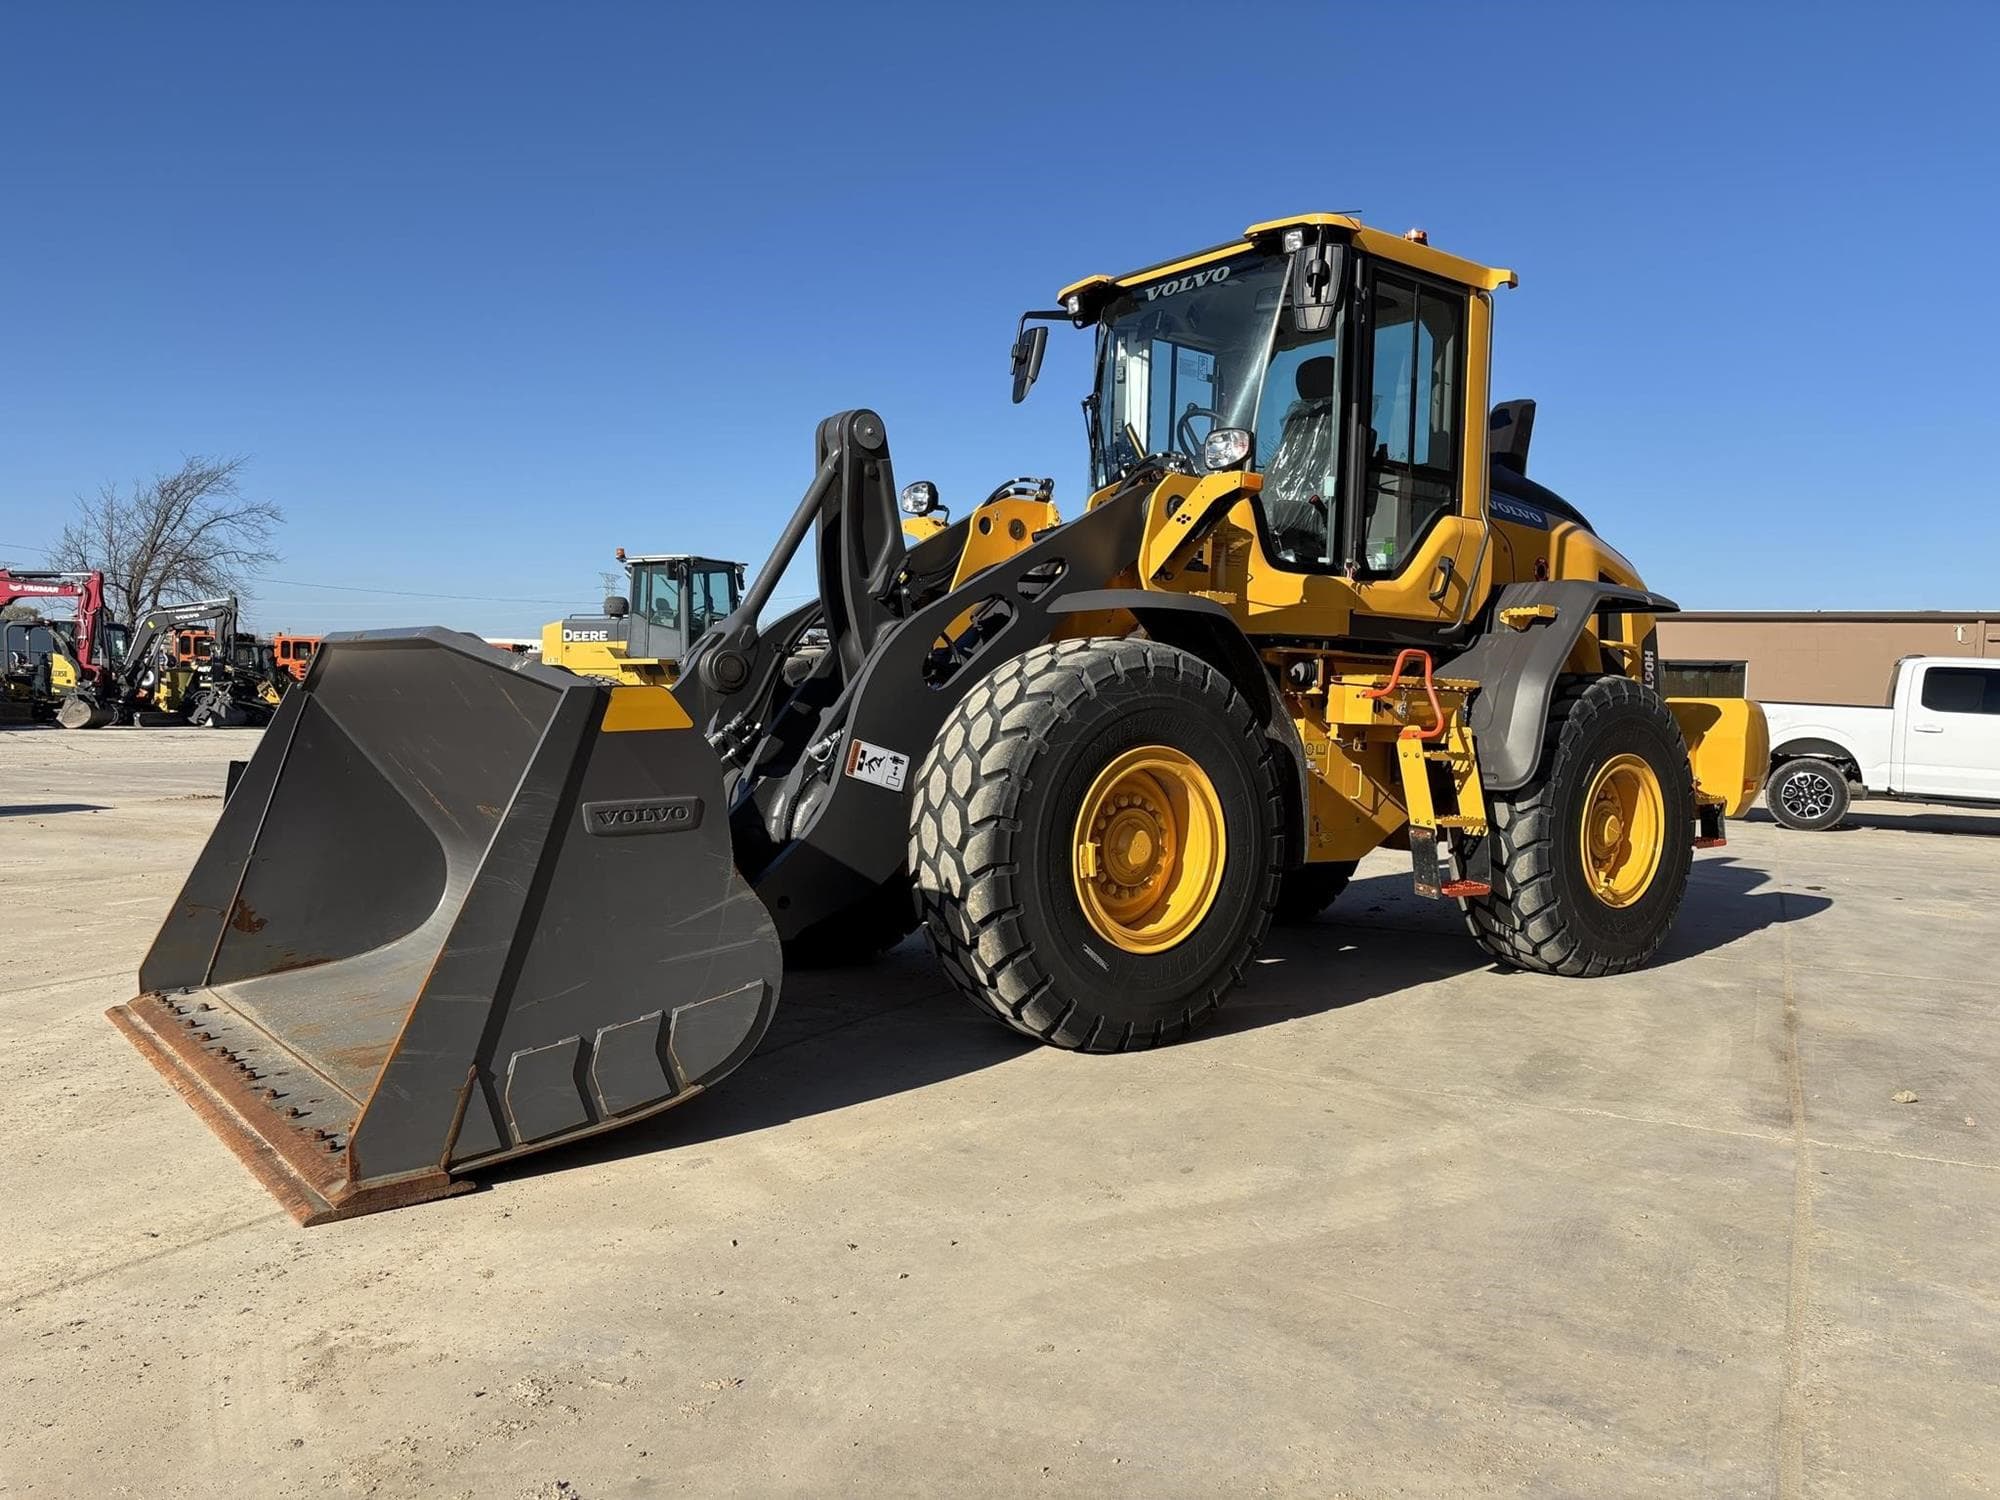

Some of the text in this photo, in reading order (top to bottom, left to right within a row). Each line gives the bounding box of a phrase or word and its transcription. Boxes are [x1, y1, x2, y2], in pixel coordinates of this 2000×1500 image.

[1144, 265, 1231, 302] VOLVO
[1489, 500, 1542, 522] VOLVO
[562, 628, 609, 642] DEERE
[1643, 649, 1655, 689] L90H
[594, 805, 691, 827] VOLVO
